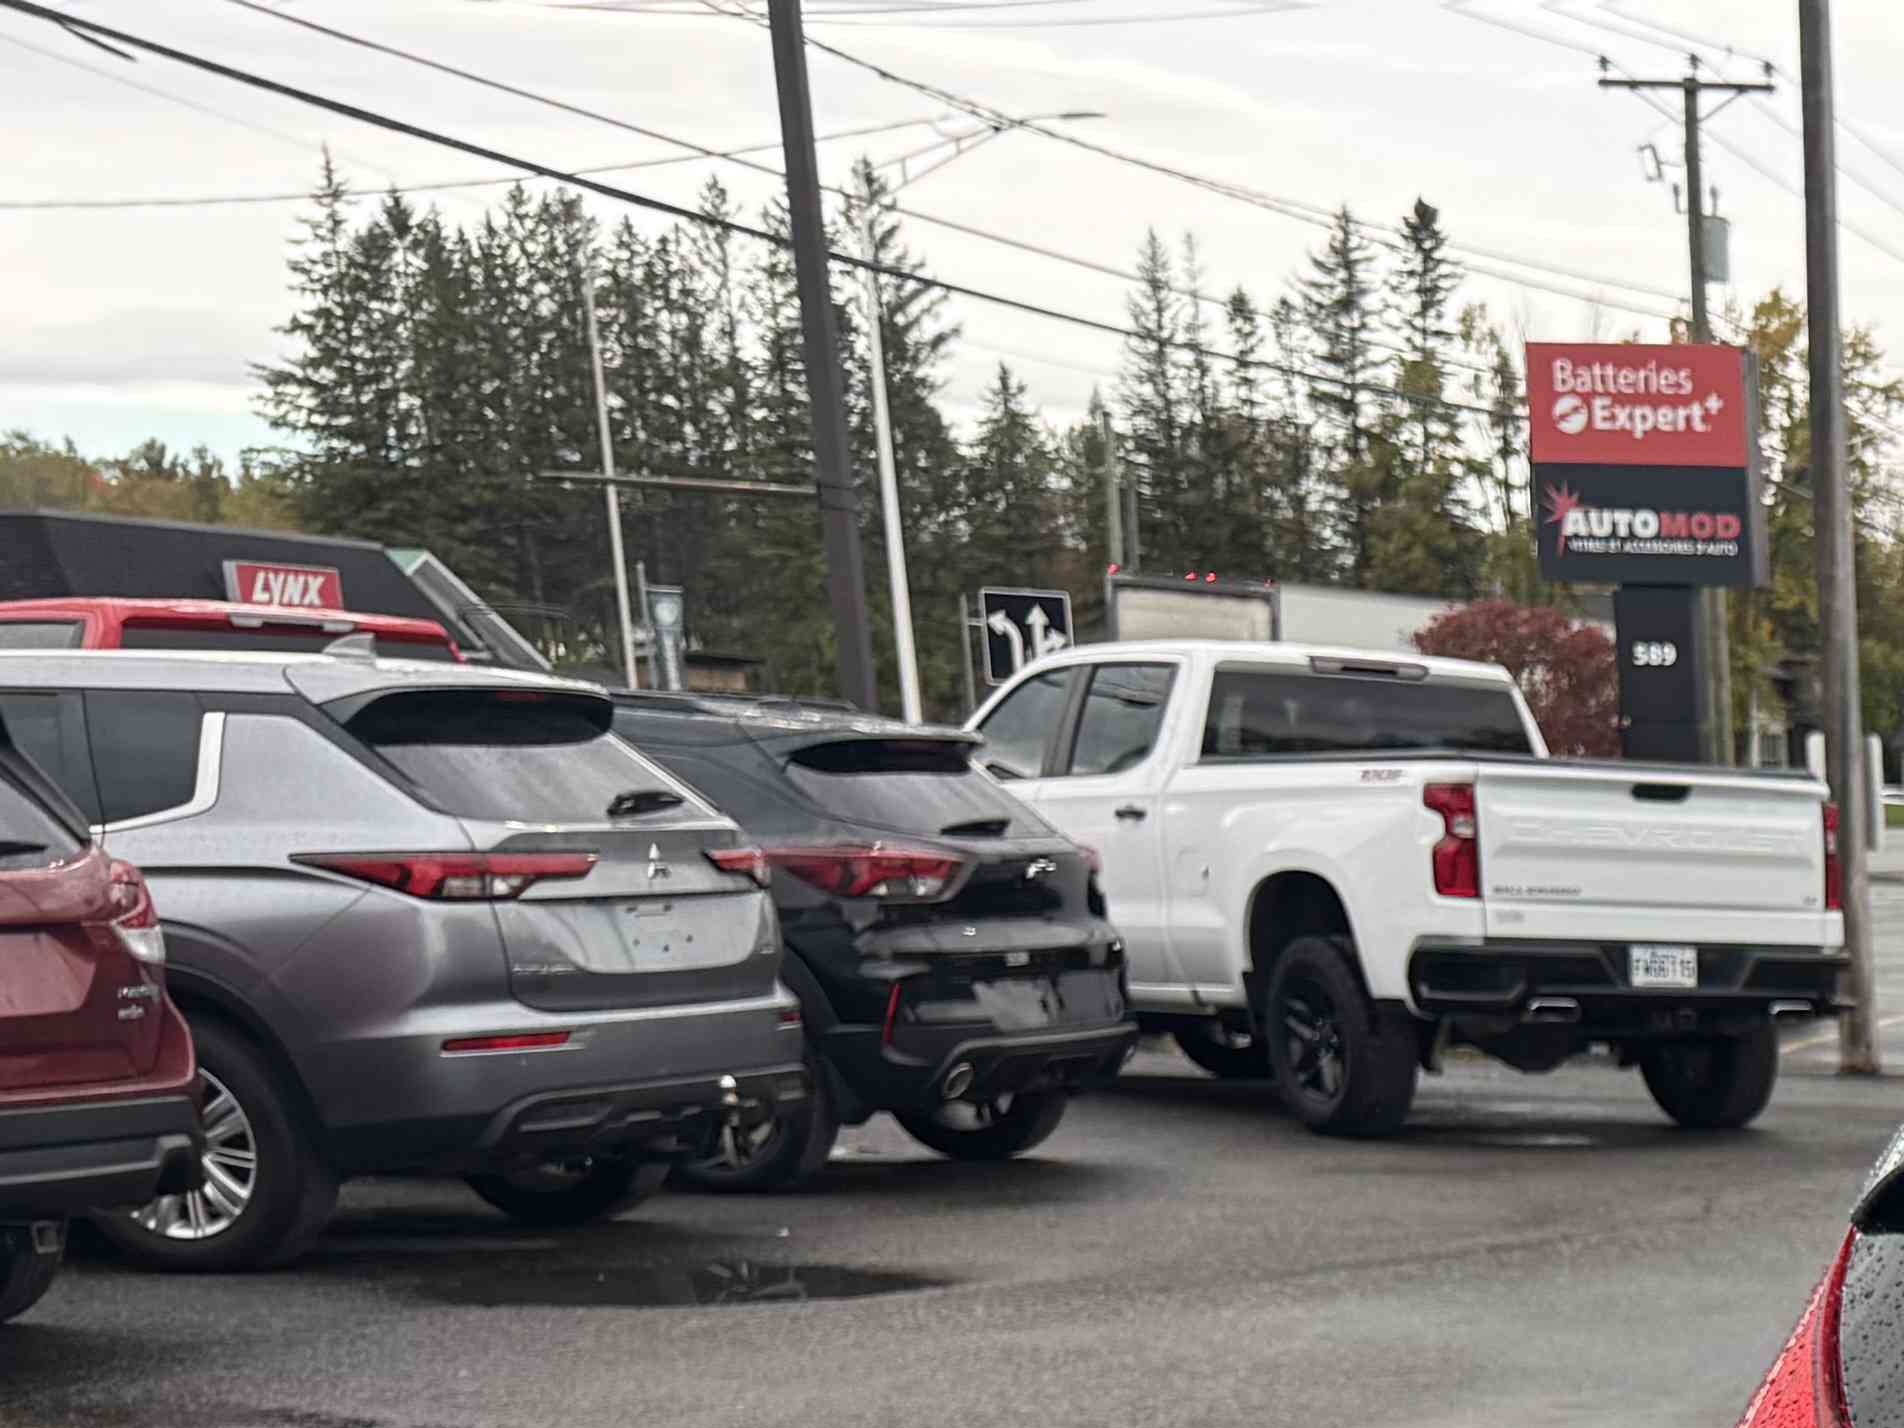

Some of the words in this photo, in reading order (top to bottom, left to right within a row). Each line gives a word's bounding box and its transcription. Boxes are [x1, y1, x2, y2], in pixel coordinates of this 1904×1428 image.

[1552, 357, 1694, 395] Batteries
[1563, 508, 1741, 539] AUTOMOD
[252, 569, 326, 607] LYNX
[1631, 640, 1678, 667] 589
